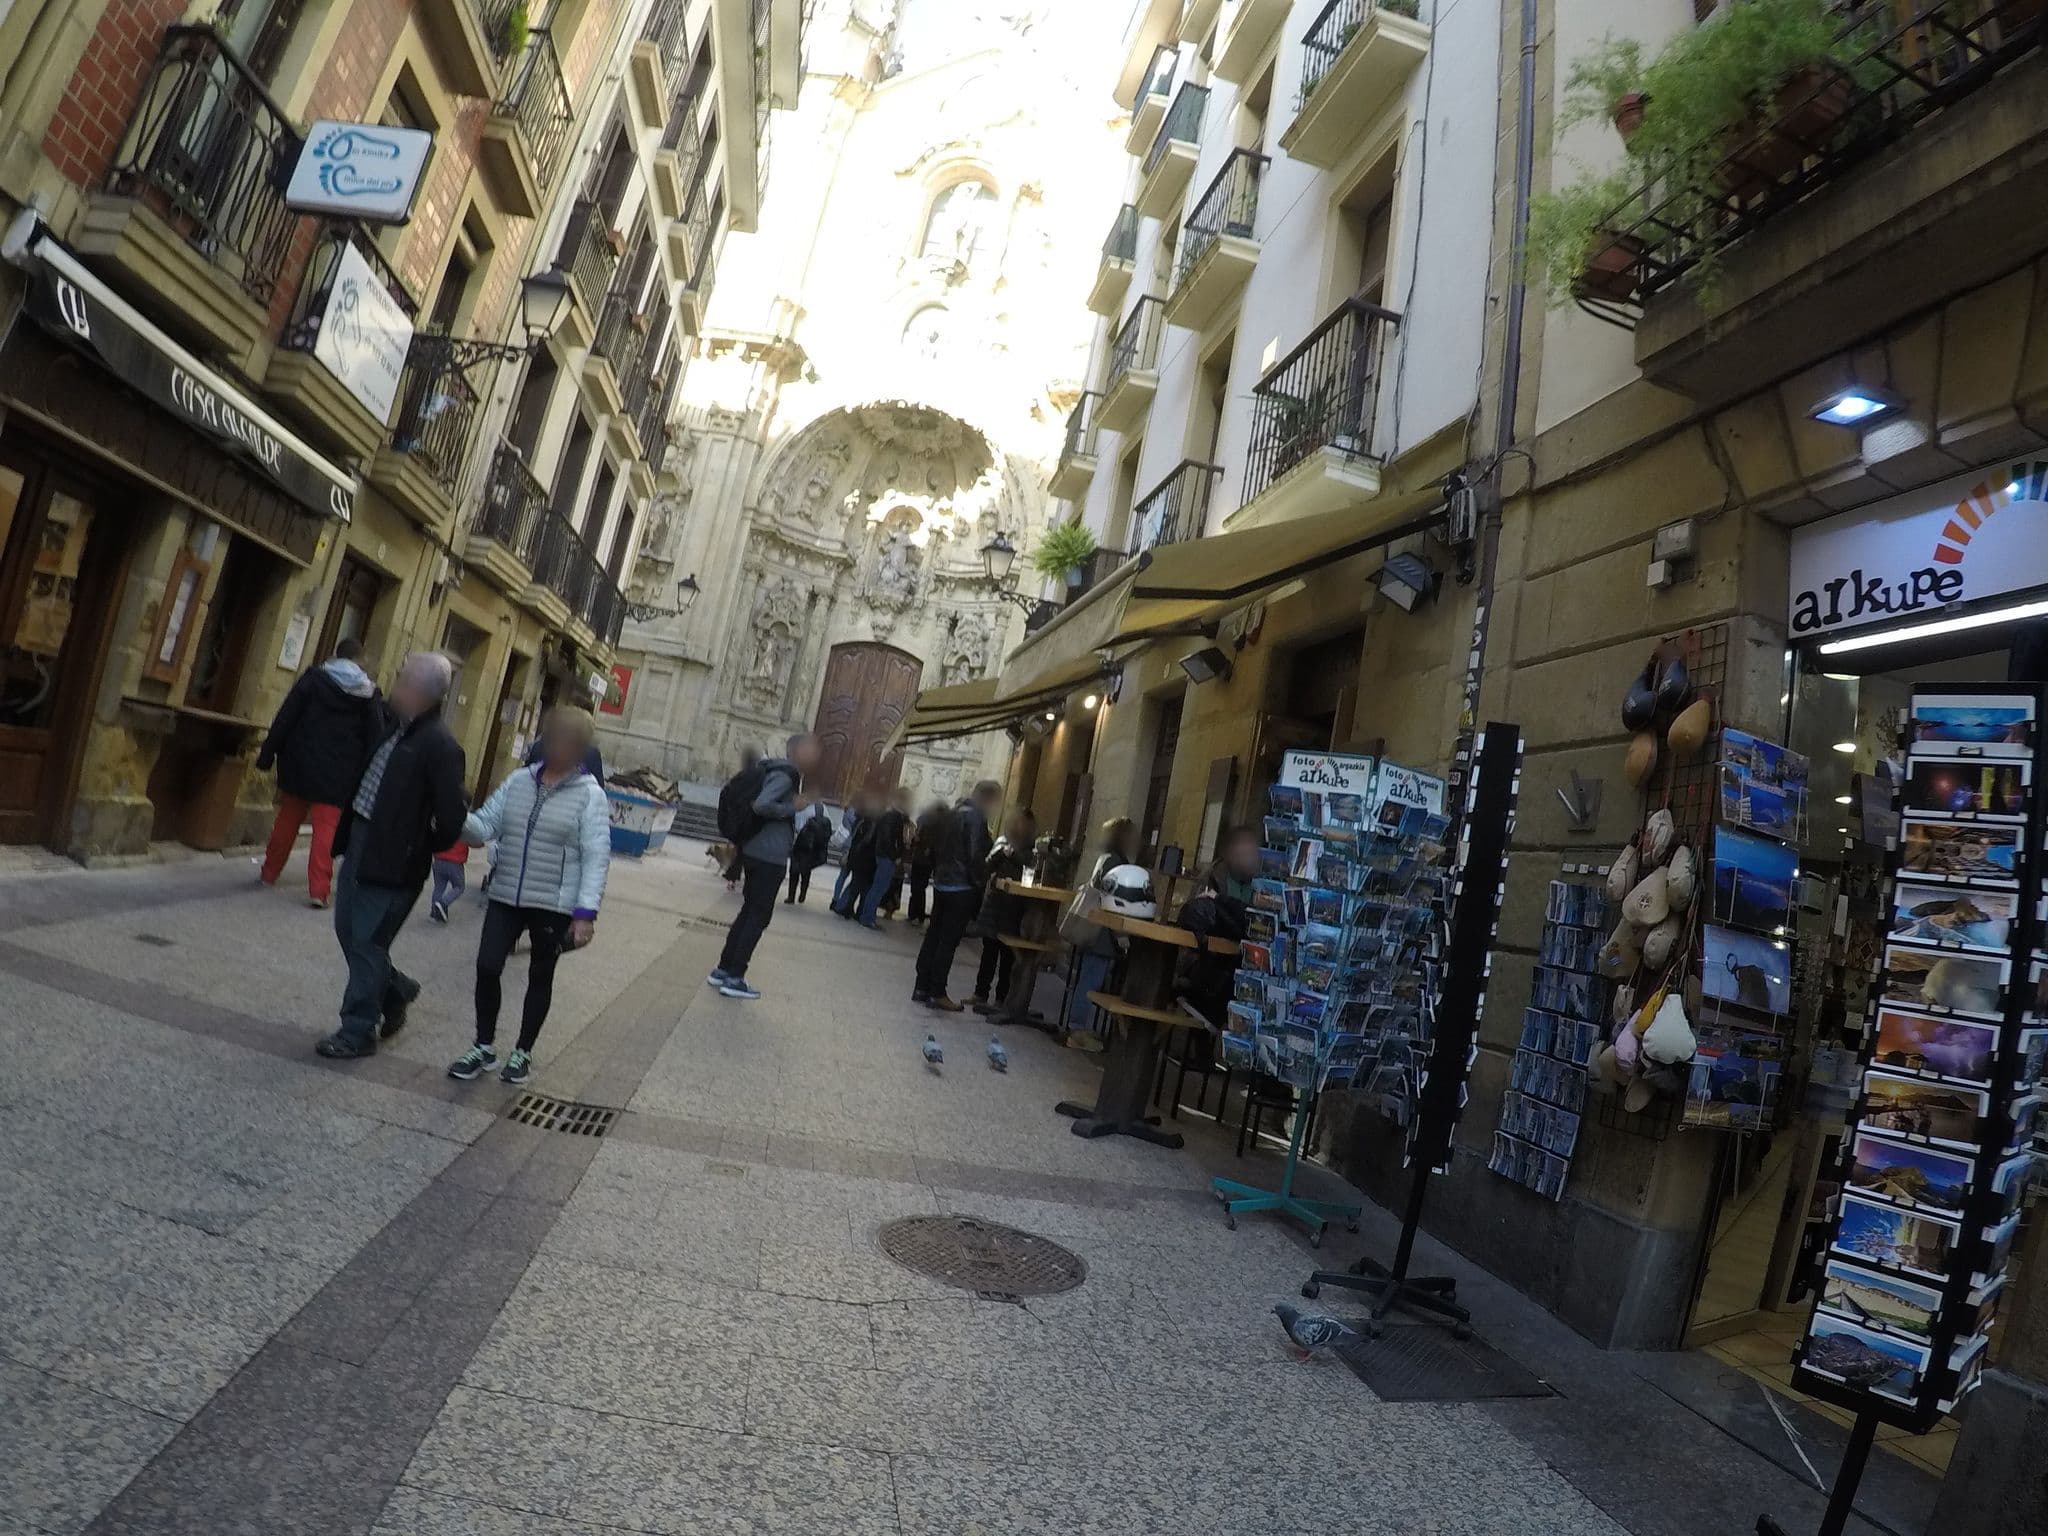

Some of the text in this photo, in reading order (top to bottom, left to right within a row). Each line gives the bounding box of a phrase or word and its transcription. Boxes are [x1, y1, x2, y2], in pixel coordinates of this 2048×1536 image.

[171, 365, 282, 474] CASA ALCALDE
[1791, 567, 1964, 632] arkupe
[1293, 755, 1315, 767] foto
[1299, 768, 1350, 788] arkupe
[1385, 767, 1403, 780] foto
[1389, 782, 1428, 806] arkupe
